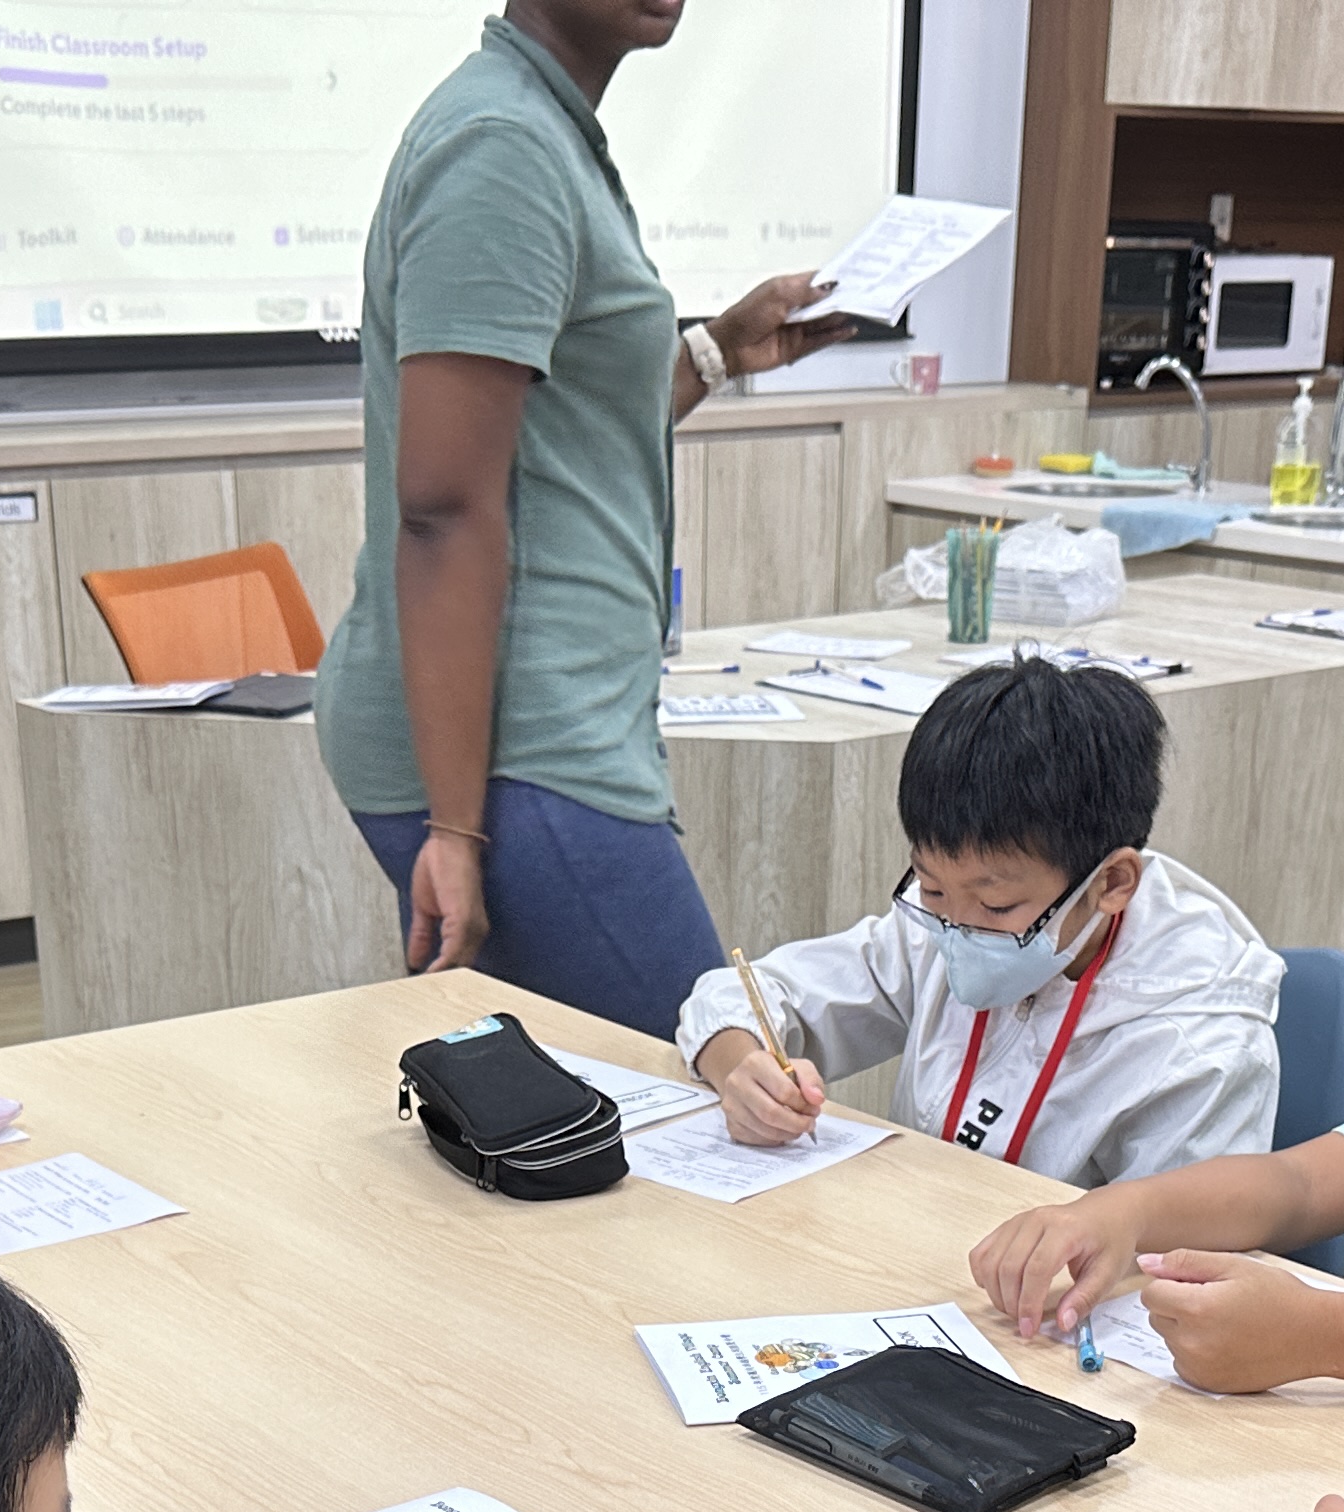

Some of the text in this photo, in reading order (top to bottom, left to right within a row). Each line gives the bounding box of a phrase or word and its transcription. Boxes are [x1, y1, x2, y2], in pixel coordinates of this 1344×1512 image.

[51, 32, 150, 58] Classroom
[153, 37, 207, 60] Setup
[0, 95, 206, 126] Complete the last 5 steps
[18, 229, 77, 250] Toolkit
